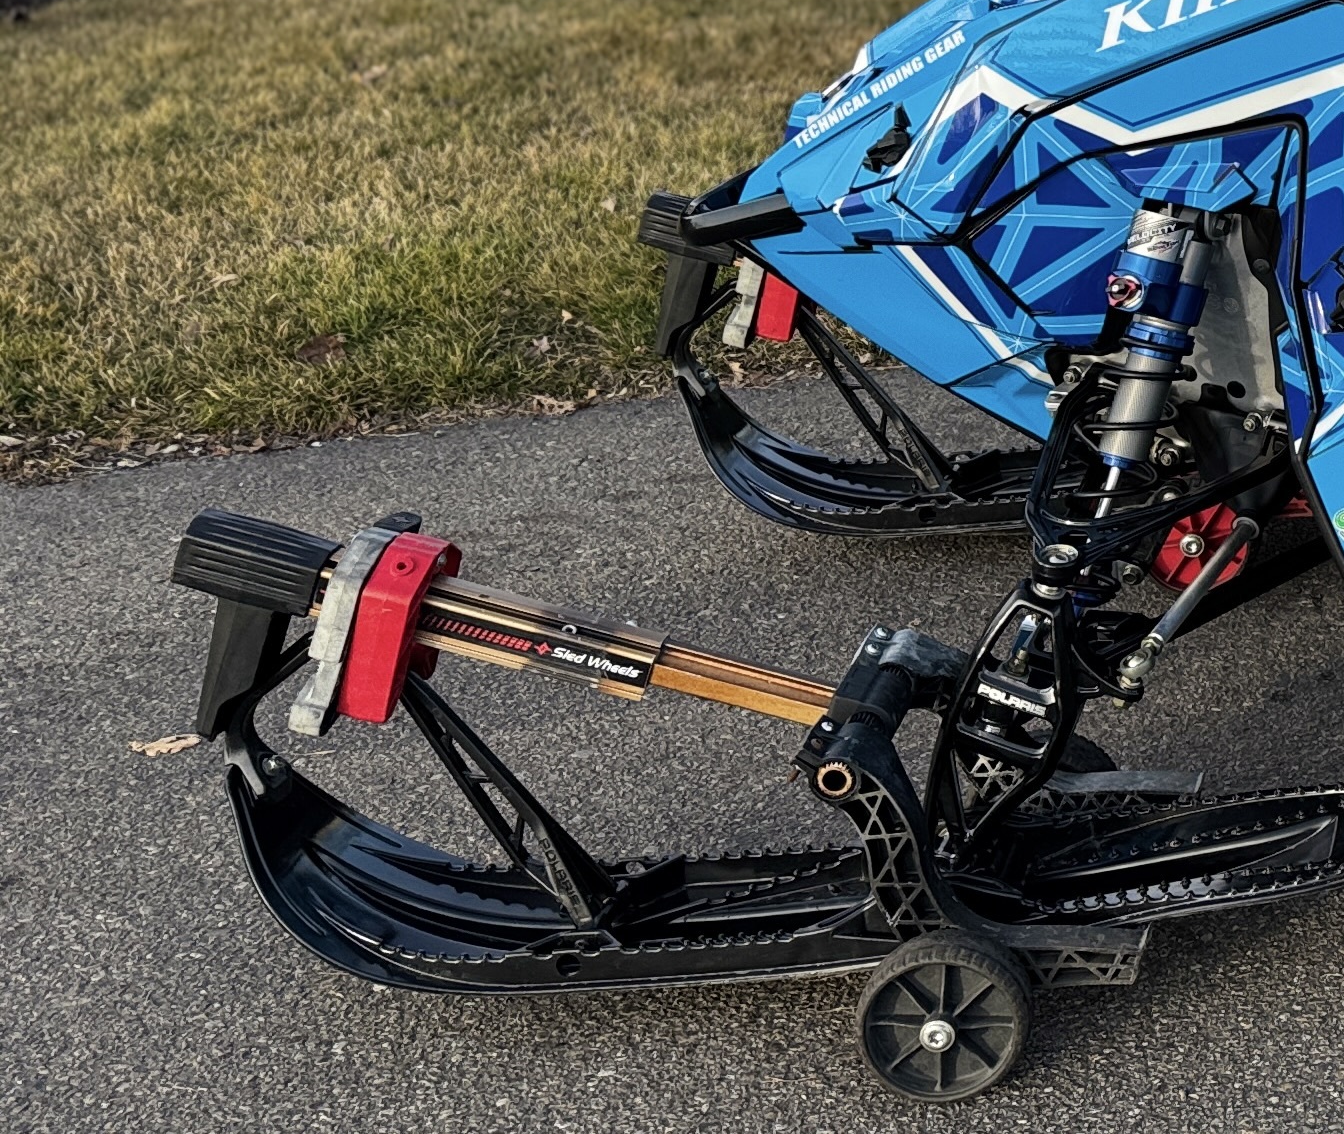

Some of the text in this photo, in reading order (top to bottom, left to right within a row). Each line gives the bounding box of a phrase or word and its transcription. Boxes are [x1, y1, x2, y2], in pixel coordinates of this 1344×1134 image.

[793, 29, 966, 149] TECHNICAL RIDING GEAR
[551, 646, 643, 679] Sled Wheels
[976, 683, 1048, 717] POLARIS
